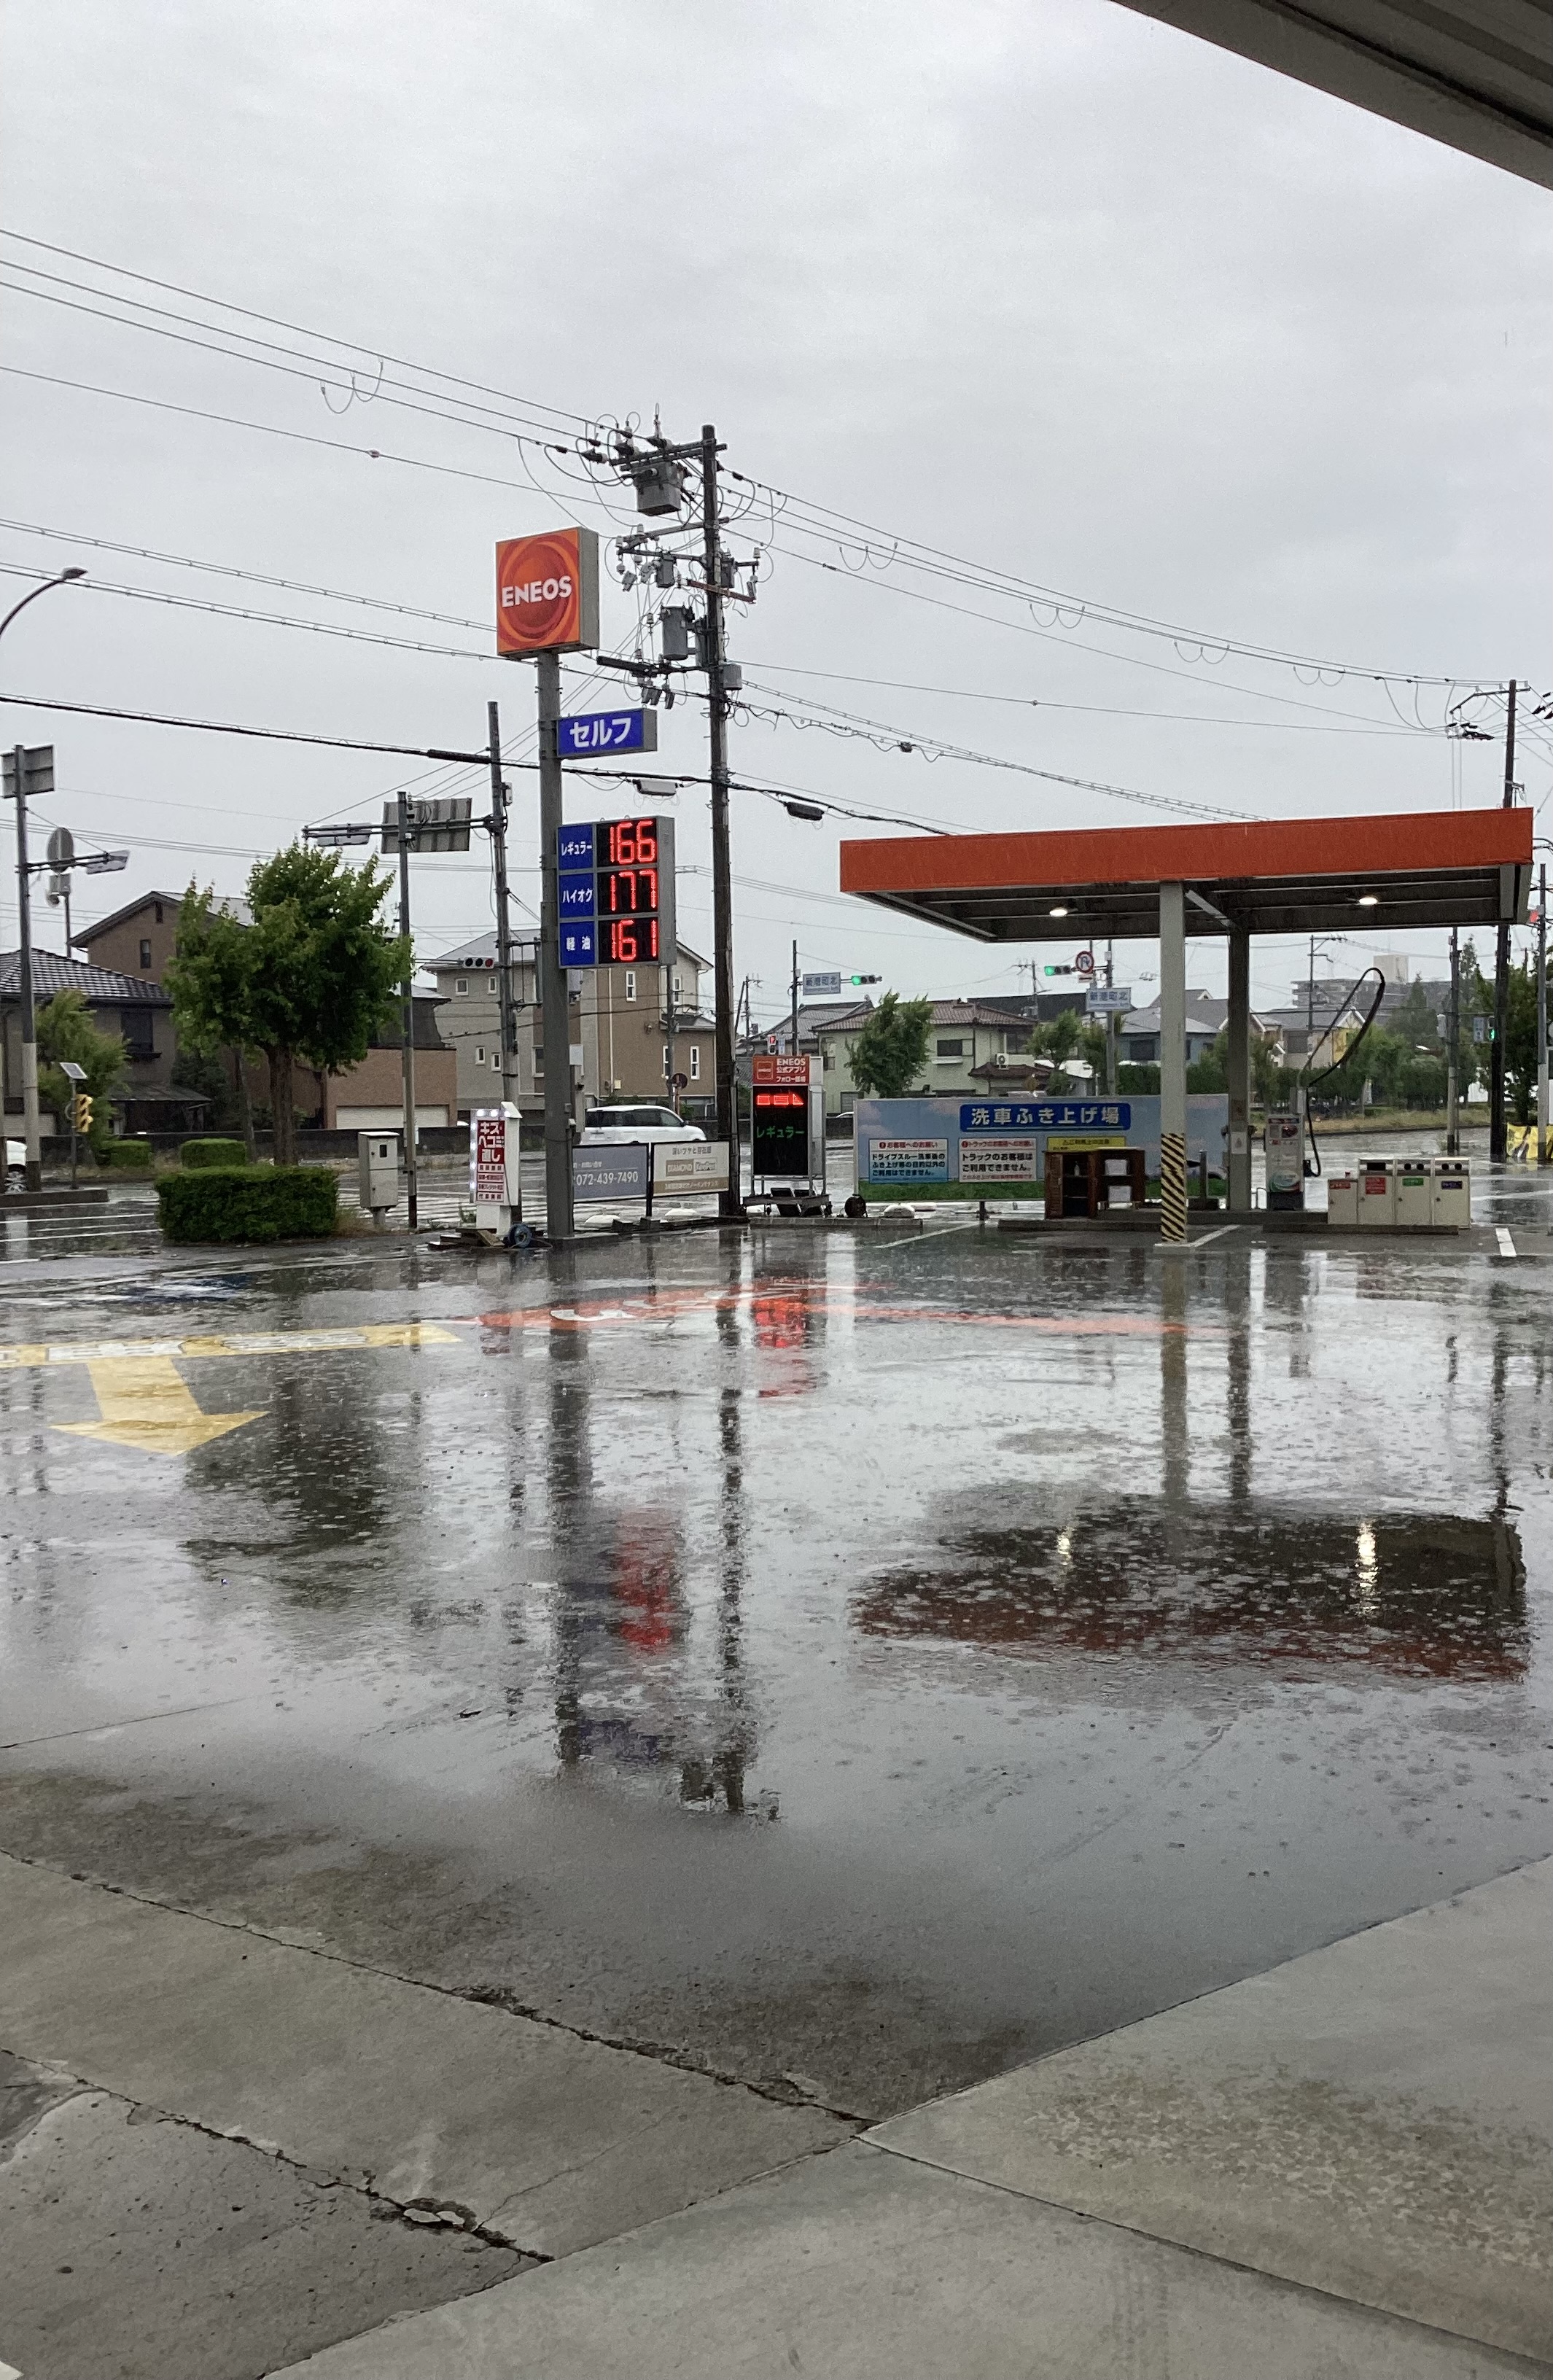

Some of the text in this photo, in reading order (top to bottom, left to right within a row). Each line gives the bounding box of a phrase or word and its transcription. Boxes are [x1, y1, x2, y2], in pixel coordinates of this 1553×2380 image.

[502, 575, 572, 608] ENEOS
[569, 718, 631, 748] セルフ
[561, 841, 593, 856] レギュラー
[610, 820, 655, 864] 166
[562, 887, 593, 903] ハイオク
[611, 869, 656, 911] 177
[612, 919, 656, 961] 161
[776, 1058, 806, 1066] ENEOS
[971, 1107, 1119, 1125] 洗車ふき上げ場
[756, 1125, 805, 1138] レギュラー
[478, 1135, 505, 1148] ヘコミ
[962, 1153, 1032, 1161] トラックのお客様は
[962, 1164, 1031, 1172] ご利用できません。
[576, 1171, 639, 1186] 072-439-7490
